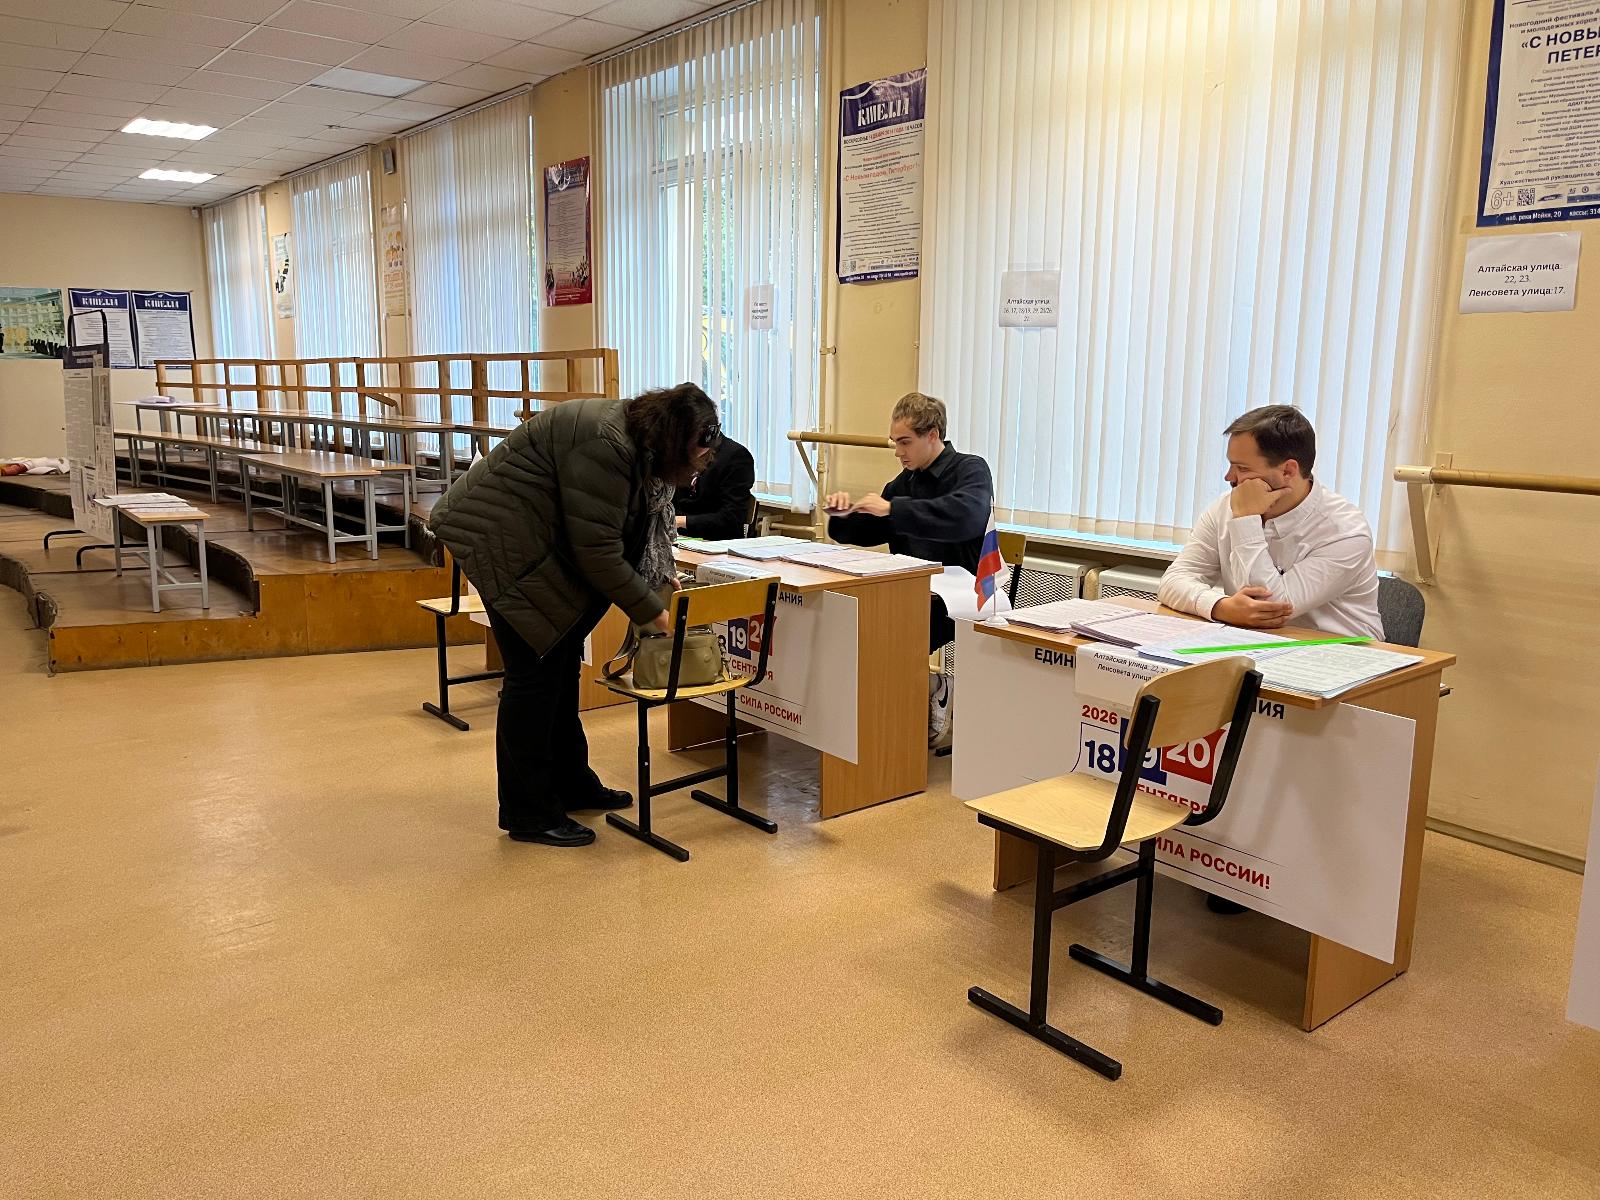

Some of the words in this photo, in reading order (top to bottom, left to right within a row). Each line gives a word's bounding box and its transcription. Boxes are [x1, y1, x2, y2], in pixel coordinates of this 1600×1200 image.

[1510, 17, 1552, 29] Новогодний
[1554, 11, 1594, 22] фестиваль
[1576, 17, 1598, 25] хоров
[1521, 36, 1541, 48] «С
[1546, 28, 1600, 46] НОВЫ
[1500, 175, 1550, 186] Художественный
[1550, 170, 1594, 181] руководитель
[1491, 190, 1514, 210] 6+
[1478, 264, 1528, 274] Алтайская
[1504, 276, 1516, 284] 22,
[1468, 288, 1519, 297] Ленсовета
[730, 625, 746, 650] 19
[1034, 648, 1076, 668] ЕДИН
[1094, 652, 1126, 665] Алтайская
[1098, 664, 1130, 677] Ленсовета
[740, 694, 762, 710] СИЛА
[764, 702, 802, 725] РОССИИ!
[1082, 704, 1118, 725] 2026
[1084, 740, 1116, 774] 18
[1166, 738, 1211, 769] 20
[1189, 847, 1270, 890] РОССИИ!
